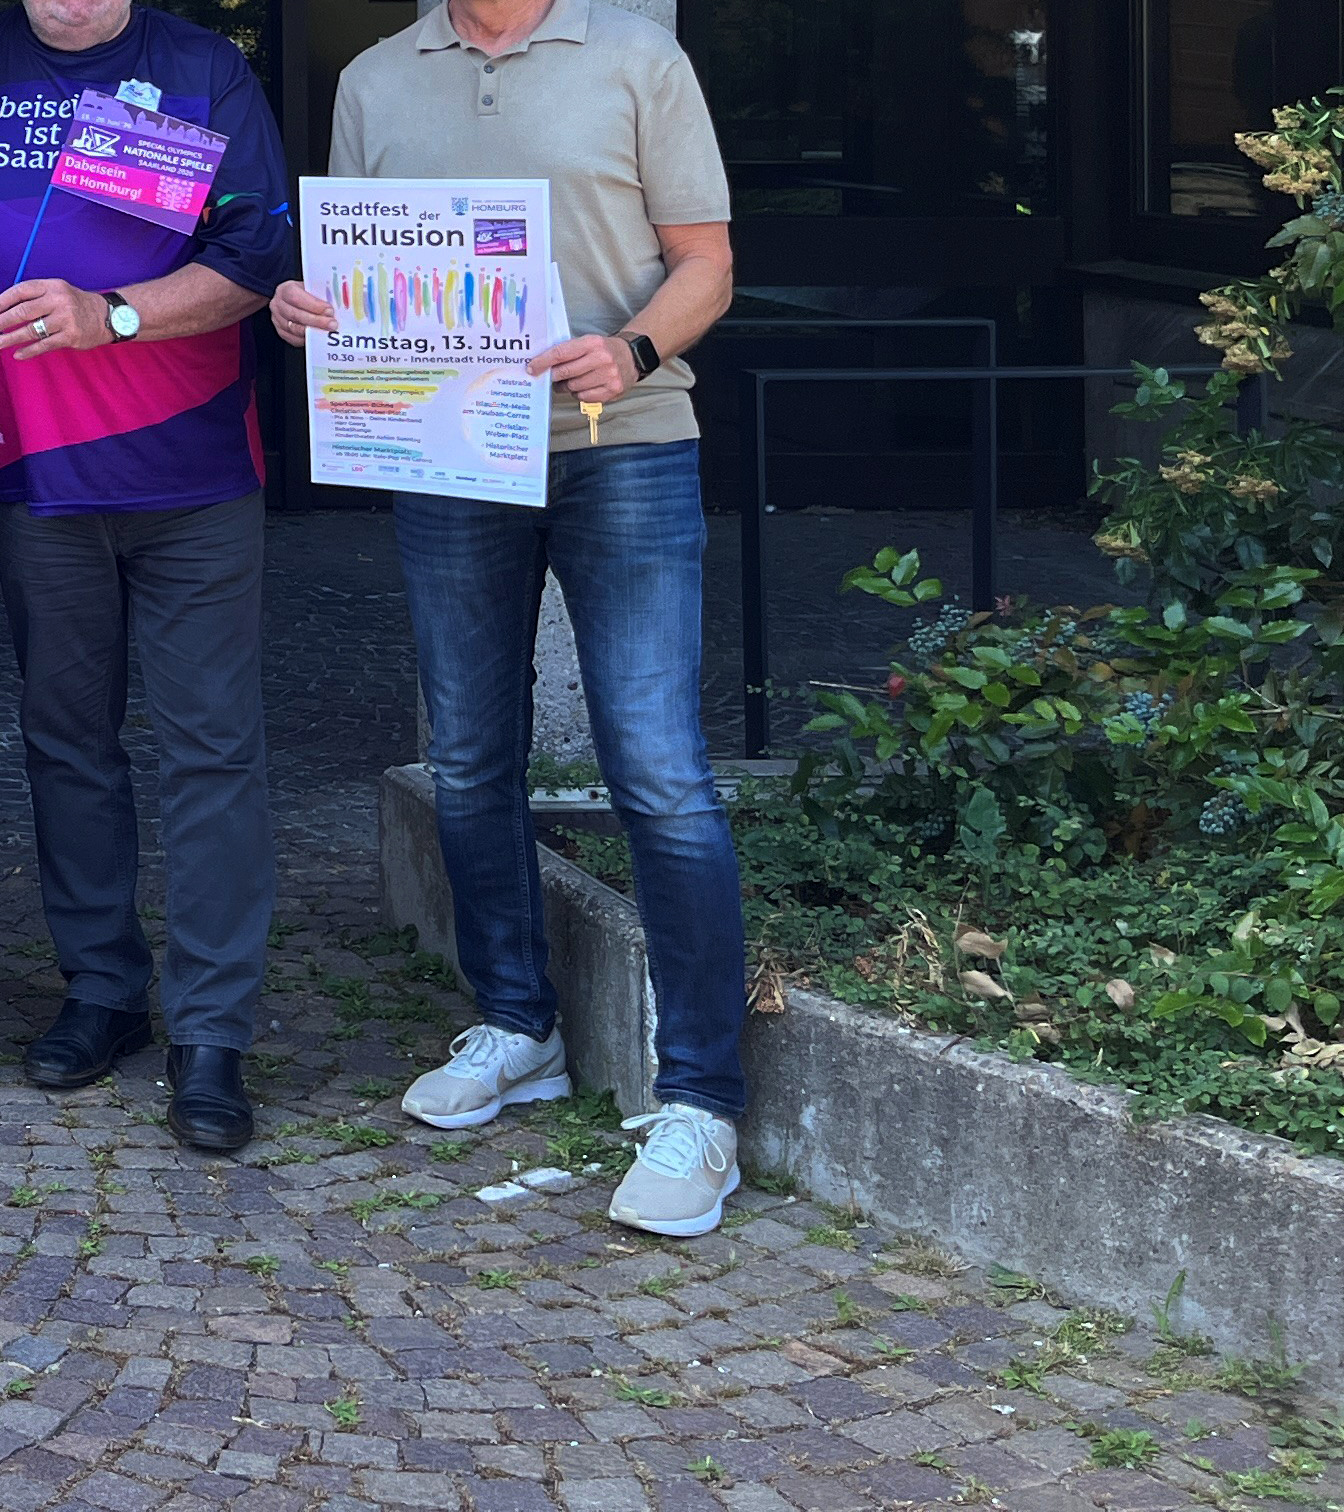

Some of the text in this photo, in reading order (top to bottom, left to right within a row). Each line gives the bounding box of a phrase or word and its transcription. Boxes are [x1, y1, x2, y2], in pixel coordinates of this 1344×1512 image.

[24, 120, 62, 145] ist
[65, 156, 127, 180] Dabeisein
[123, 145, 213, 173] NATIONALE SPIELE
[61, 172, 142, 200] ist Homburg!
[320, 202, 441, 221] Stadtfest der
[321, 223, 465, 247] Inklusion
[327, 331, 531, 353] Samstag, 13. Juni
[327, 353, 355, 362] 10.30
[366, 355, 378, 363] 18
[380, 355, 401, 364] Uhr
[411, 355, 474, 364] Innenstadt
